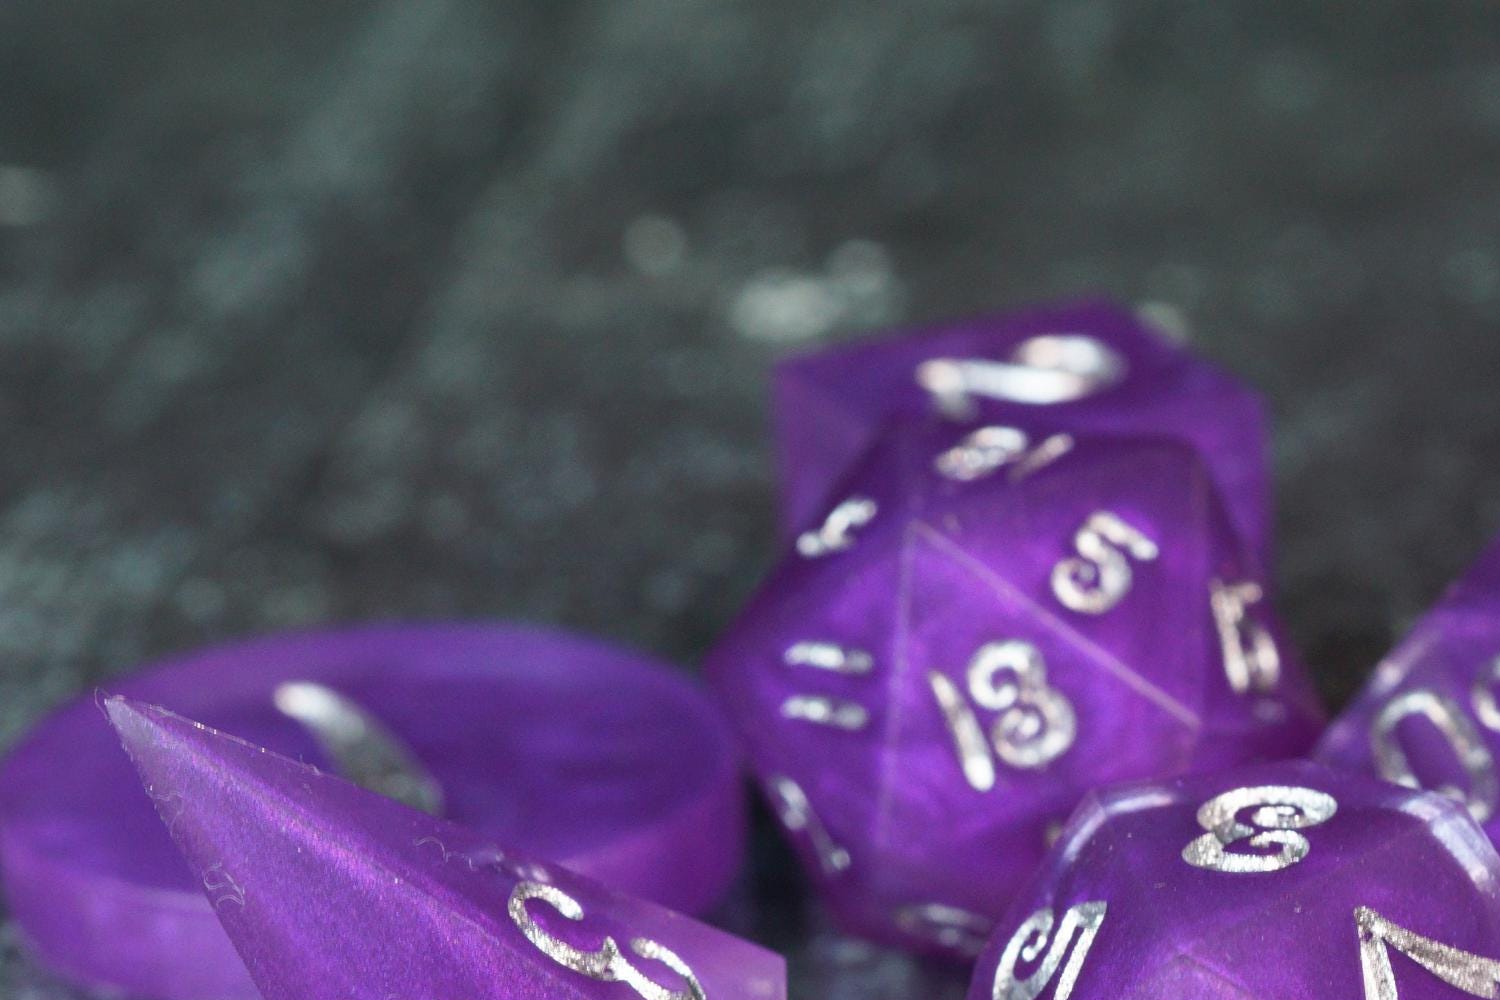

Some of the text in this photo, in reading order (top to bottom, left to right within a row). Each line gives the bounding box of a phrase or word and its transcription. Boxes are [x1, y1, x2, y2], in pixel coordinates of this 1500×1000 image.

[1049, 508, 1160, 615] 5
[928, 638, 1078, 794] 13
[1180, 784, 1339, 874] 3
